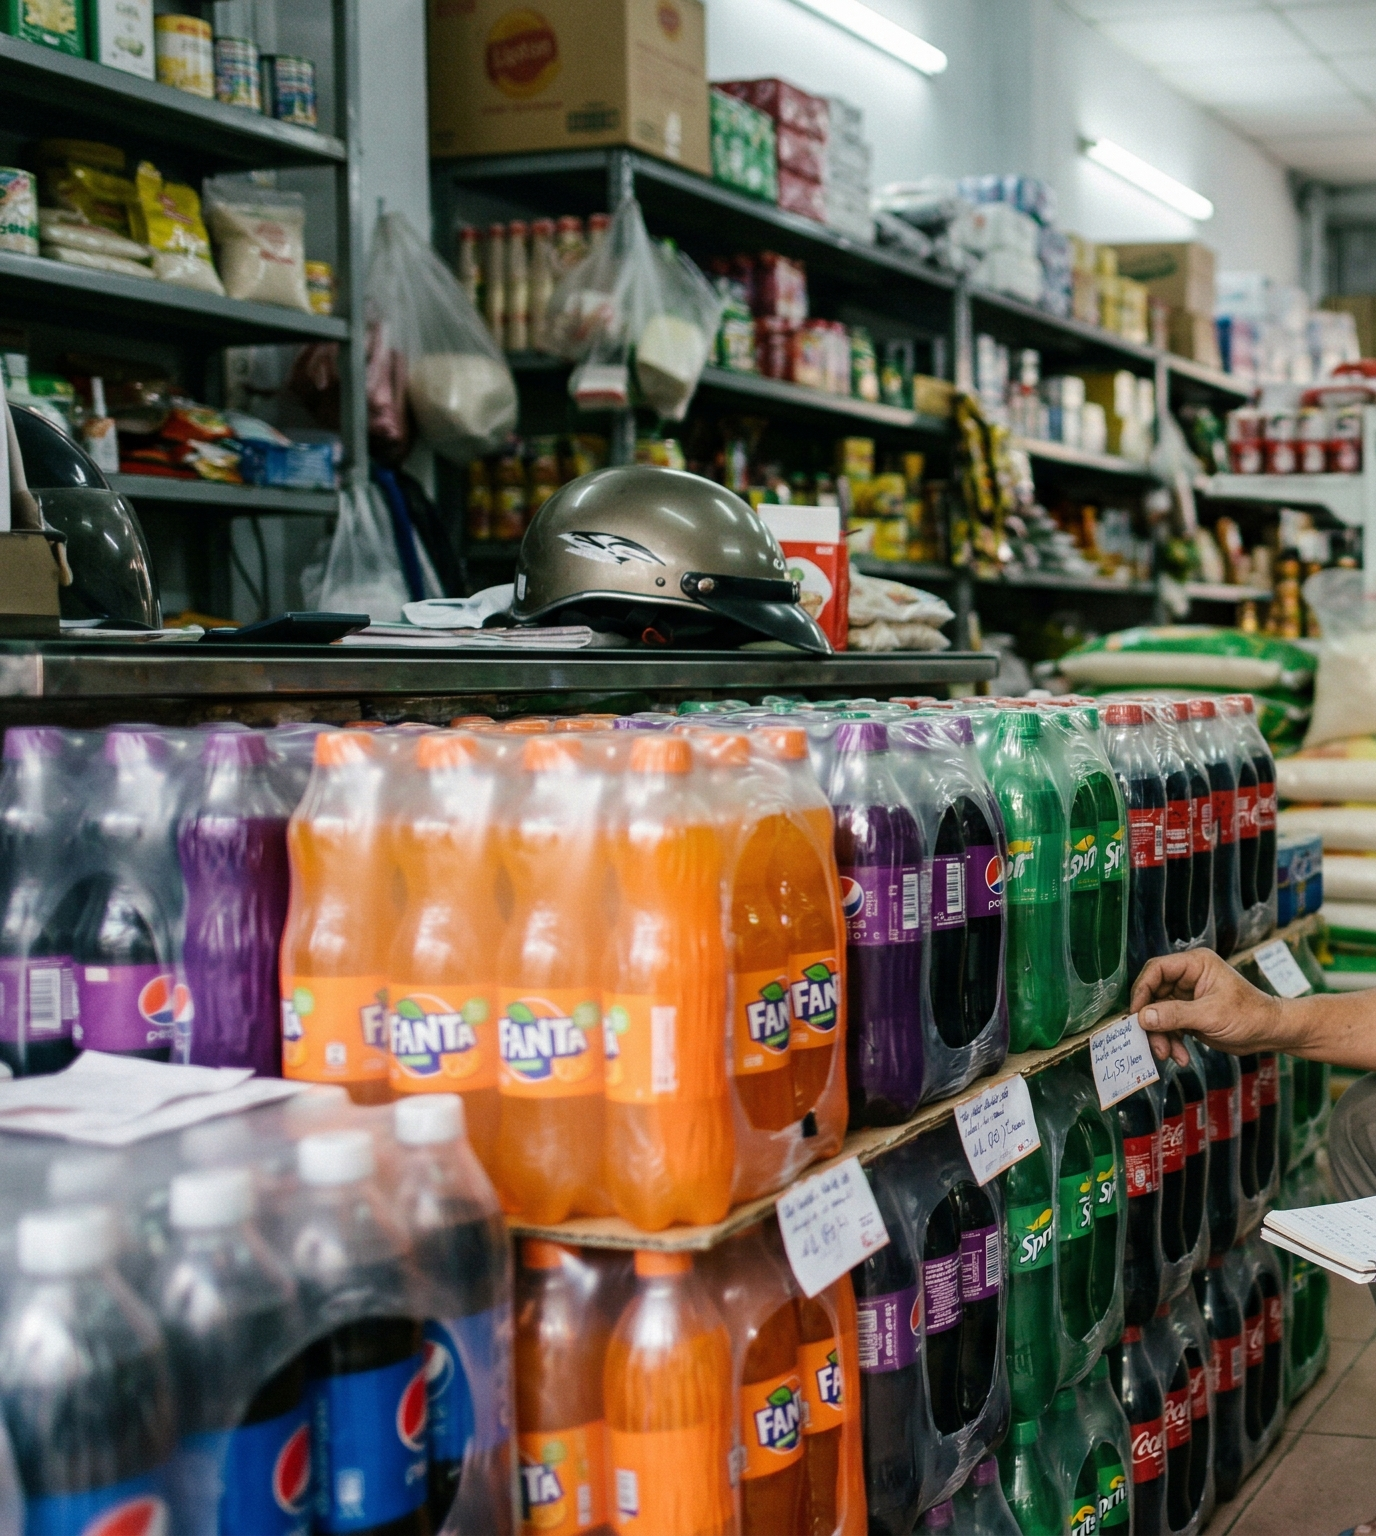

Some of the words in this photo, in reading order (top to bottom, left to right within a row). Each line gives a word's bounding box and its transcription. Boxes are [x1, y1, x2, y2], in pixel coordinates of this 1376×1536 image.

[790, 973, 839, 1018] FAN
[390, 1012, 477, 1056] FANTA
[498, 1017, 588, 1060] FANTA
[755, 1390, 802, 1446] FAN
